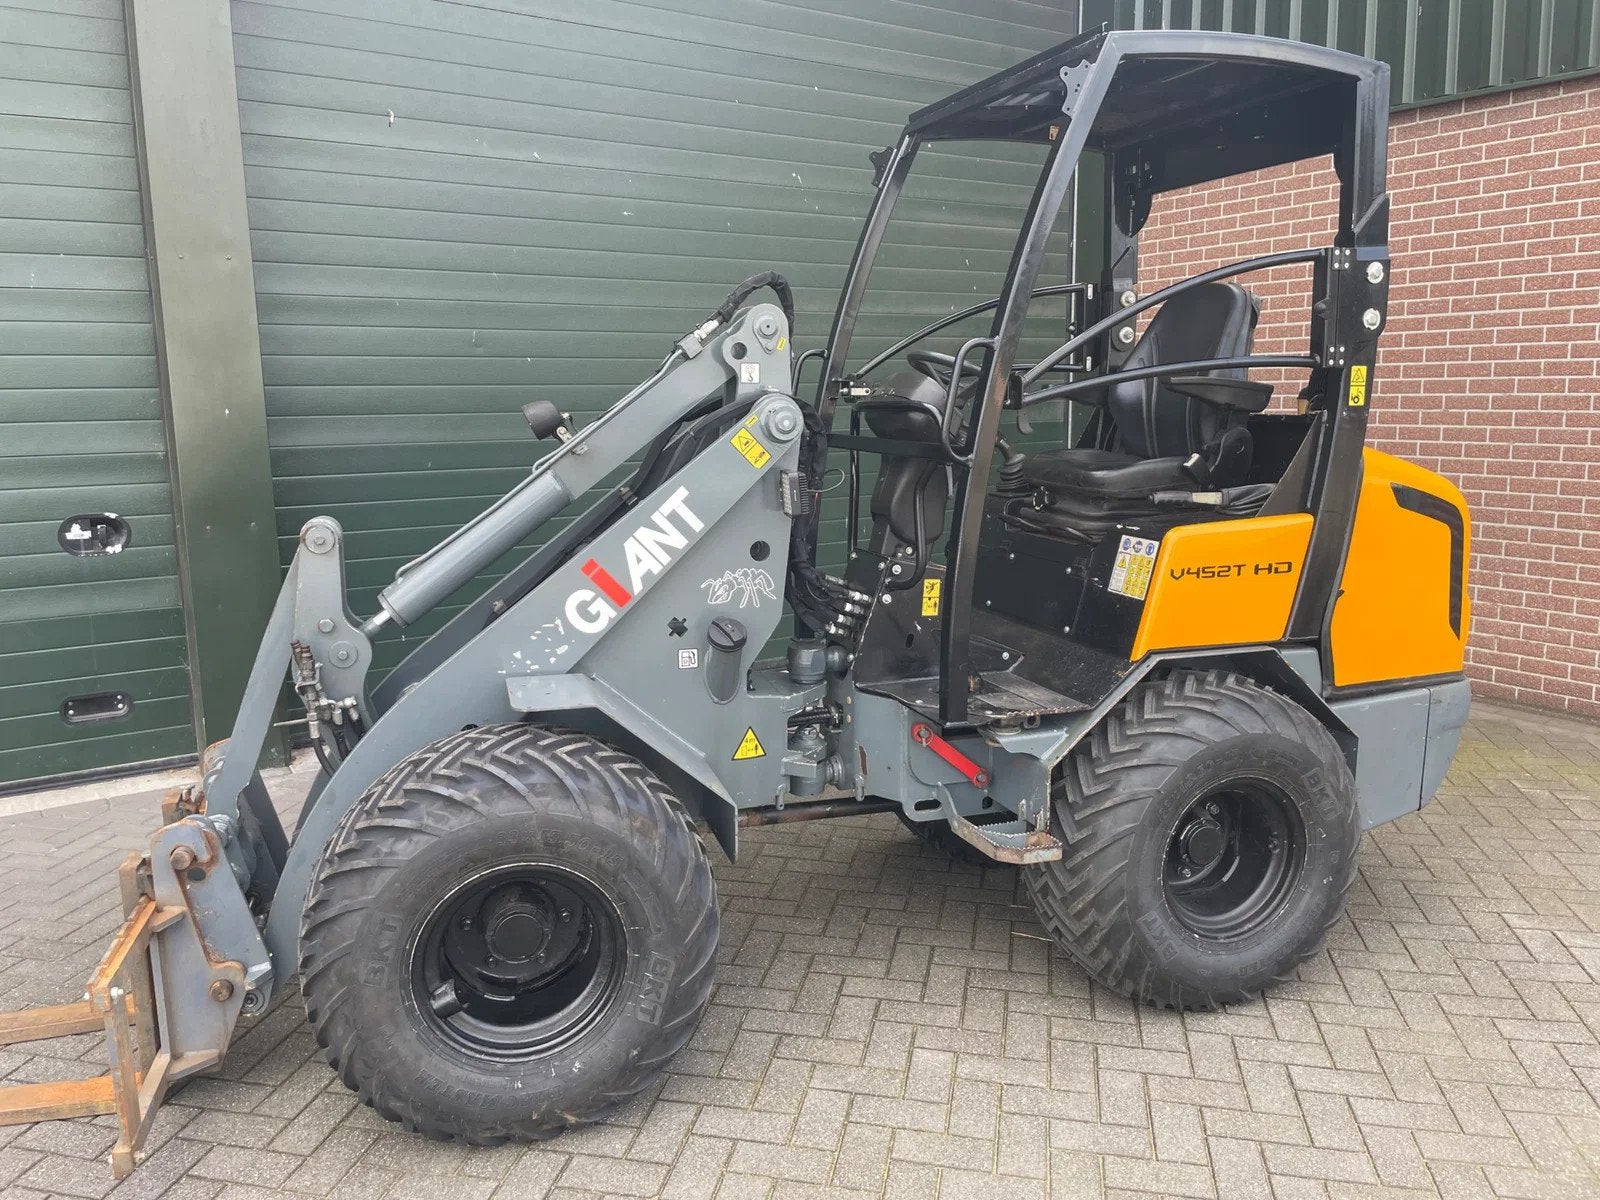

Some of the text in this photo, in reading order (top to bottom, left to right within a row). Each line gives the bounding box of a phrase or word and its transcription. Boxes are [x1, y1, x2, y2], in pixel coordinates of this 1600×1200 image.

[1170, 561, 1293, 581] V452T HD
[1303, 767, 1343, 820] BKT
[360, 912, 402, 988] BKT
[1136, 911, 1178, 960] BKT
[637, 951, 675, 1025] BKT
